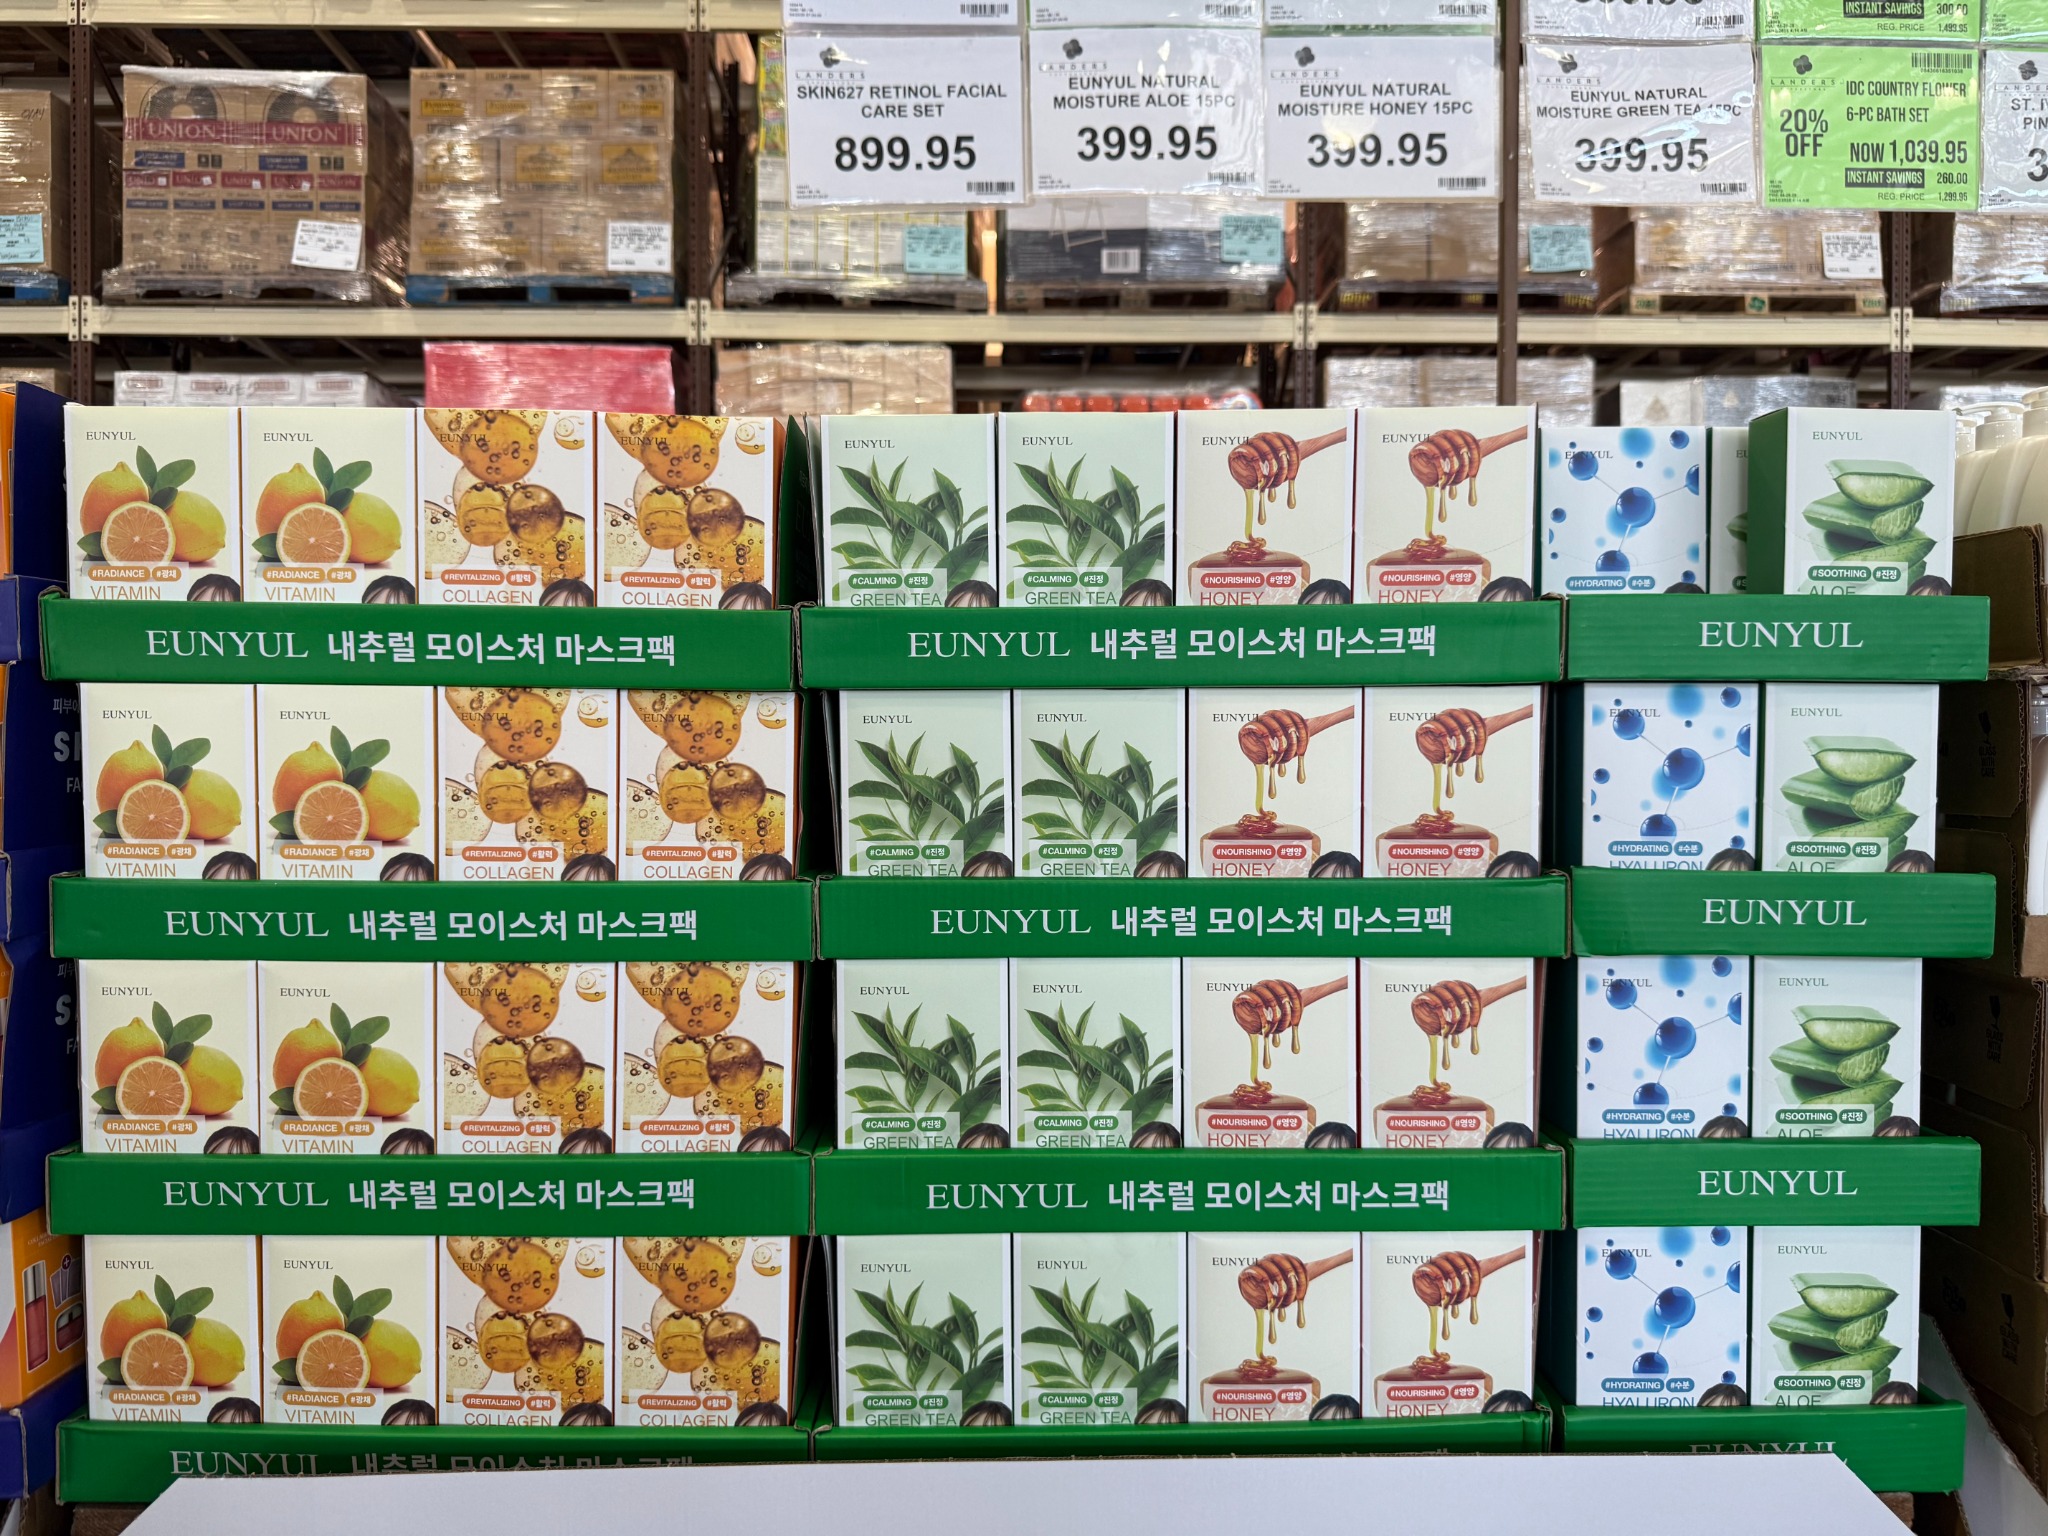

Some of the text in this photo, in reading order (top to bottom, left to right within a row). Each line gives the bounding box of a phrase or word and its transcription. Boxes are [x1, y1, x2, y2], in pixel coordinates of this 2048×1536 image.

[1845, 2, 1922, 15] INSTANT SAVINGS
[1878, 23, 1898, 31] REG.
[1900, 23, 1924, 31] PRICE
[796, 72, 866, 80] LANDERS
[1536, 77, 1600, 85] LANDERS
[1068, 75, 1220, 90] EUNYUL NATURAL
[1770, 78, 1836, 86] LANDERS
[797, 85, 1007, 99] SKIN627 RETINOL FACIAL
[1300, 83, 1451, 97] EUNYUL NATURAL
[1570, 87, 1707, 102] EUNYUL NATURAL
[1846, 81, 1864, 96] IDC
[1868, 82, 1919, 97] COUNTRY
[1053, 94, 1236, 109] MOISTURE ALOE 15PC
[2011, 98, 2035, 111] ST.
[861, 104, 944, 118] CARE SET
[1278, 101, 1473, 116] MOISTURE HONEY 15PC
[1537, 106, 1612, 118] MOISTURE
[1617, 105, 1670, 117] GREEN
[1674, 104, 1701, 115] TEA
[1847, 107, 1929, 123] 6-PC BATH SET
[1780, 109, 1828, 133] 20%
[149, 123, 216, 139] UNION
[272, 126, 339, 141] UNION
[1077, 125, 1217, 161] 399.95
[1785, 134, 1824, 157] OFF
[834, 136, 976, 171] 899.95
[1308, 132, 1447, 168] 399.95
[1575, 137, 1709, 173] 399.95
[1850, 140, 1968, 166] NOW 1,039.95
[1847, 171, 1923, 184] INSTANT SAVINGS
[1937, 173, 1968, 184] 260.00
[1938, 192, 1968, 202] 1,299.95
[86, 431, 136, 441] EUNYUL
[1022, 436, 1073, 446] EUNYUL
[1564, 450, 1614, 460] EUNYUL
[92, 569, 145, 578] #RADIANCE
[156, 569, 177, 579] #광채
[1027, 575, 1072, 583] #CALMING
[1083, 574, 1104, 584] #진정
[1569, 579, 1623, 588] #HYDRATING
[1632, 579, 1651, 588] #수분
[90, 585, 161, 600] VITAMIN
[1025, 591, 1117, 605] GREEN TEA
[1699, 621, 1864, 648] EUNYUL
[907, 624, 1436, 660] EUNYUL 내추럴 모이스처 마스크팩
[146, 630, 675, 667] EUNYUL 내추럴 모이스처 마스크팩
[461, 712, 513, 722] EUNYUL
[1389, 712, 1440, 722] EUNYUL
[1791, 707, 1843, 717] EUNYUL
[465, 850, 522, 858] #REVITALIZING
[532, 849, 553, 859] #활력
[1391, 848, 1449, 856] #NOURISHING
[1457, 847, 1479, 857] #영양
[1790, 845, 1846, 854] #SOOTHING
[1855, 844, 1877, 855] #진정
[463, 866, 554, 880] COLLAGEN
[1387, 862, 1452, 877] HONEY
[1703, 898, 1867, 926] EUNYUL
[166, 910, 697, 941] EUNYUL 내추럴 모이스처 마스크팩
[931, 905, 1452, 937] EUNYUL 내추럴 모이스처 마스크팩
[280, 987, 331, 998] EUNYUL
[860, 986, 910, 996] EUNYUL
[283, 1123, 338, 1132] #RADIANCE
[349, 1123, 370, 1133] #광채
[865, 1120, 910, 1129] #CALMING
[921, 1119, 942, 1129] #진정
[1211, 1118, 1268, 1127] #NOURISHING
[1276, 1118, 1298, 1127] #영양
[863, 1136, 955, 1149] GREEN TEA
[1207, 1132, 1271, 1148] HONEY
[282, 1139, 354, 1154] VITAMIN
[1698, 1170, 1858, 1196] EUNYUL
[164, 1178, 694, 1210] EUNYUL 내추럴 모이스처 마스크팩
[928, 1180, 1448, 1211] EUNYUL 내추럴 모이스처 마스크팩
[1601, 1248, 1652, 1258] EUNYUL
[638, 1262, 689, 1272] EUNYUL
[1037, 1260, 1088, 1270] EUNYUL
[1605, 1381, 1661, 1389] #HYDRATING
[1670, 1380, 1690, 1390] #수분
[641, 1399, 697, 1407] #REVITALIZING
[706, 1399, 727, 1408] #활력
[1042, 1396, 1087, 1404] #CALMING
[1098, 1395, 1119, 1404] #진정
[639, 1414, 728, 1427] COLLAGEN
[1040, 1411, 1132, 1425] GREEN TEA
